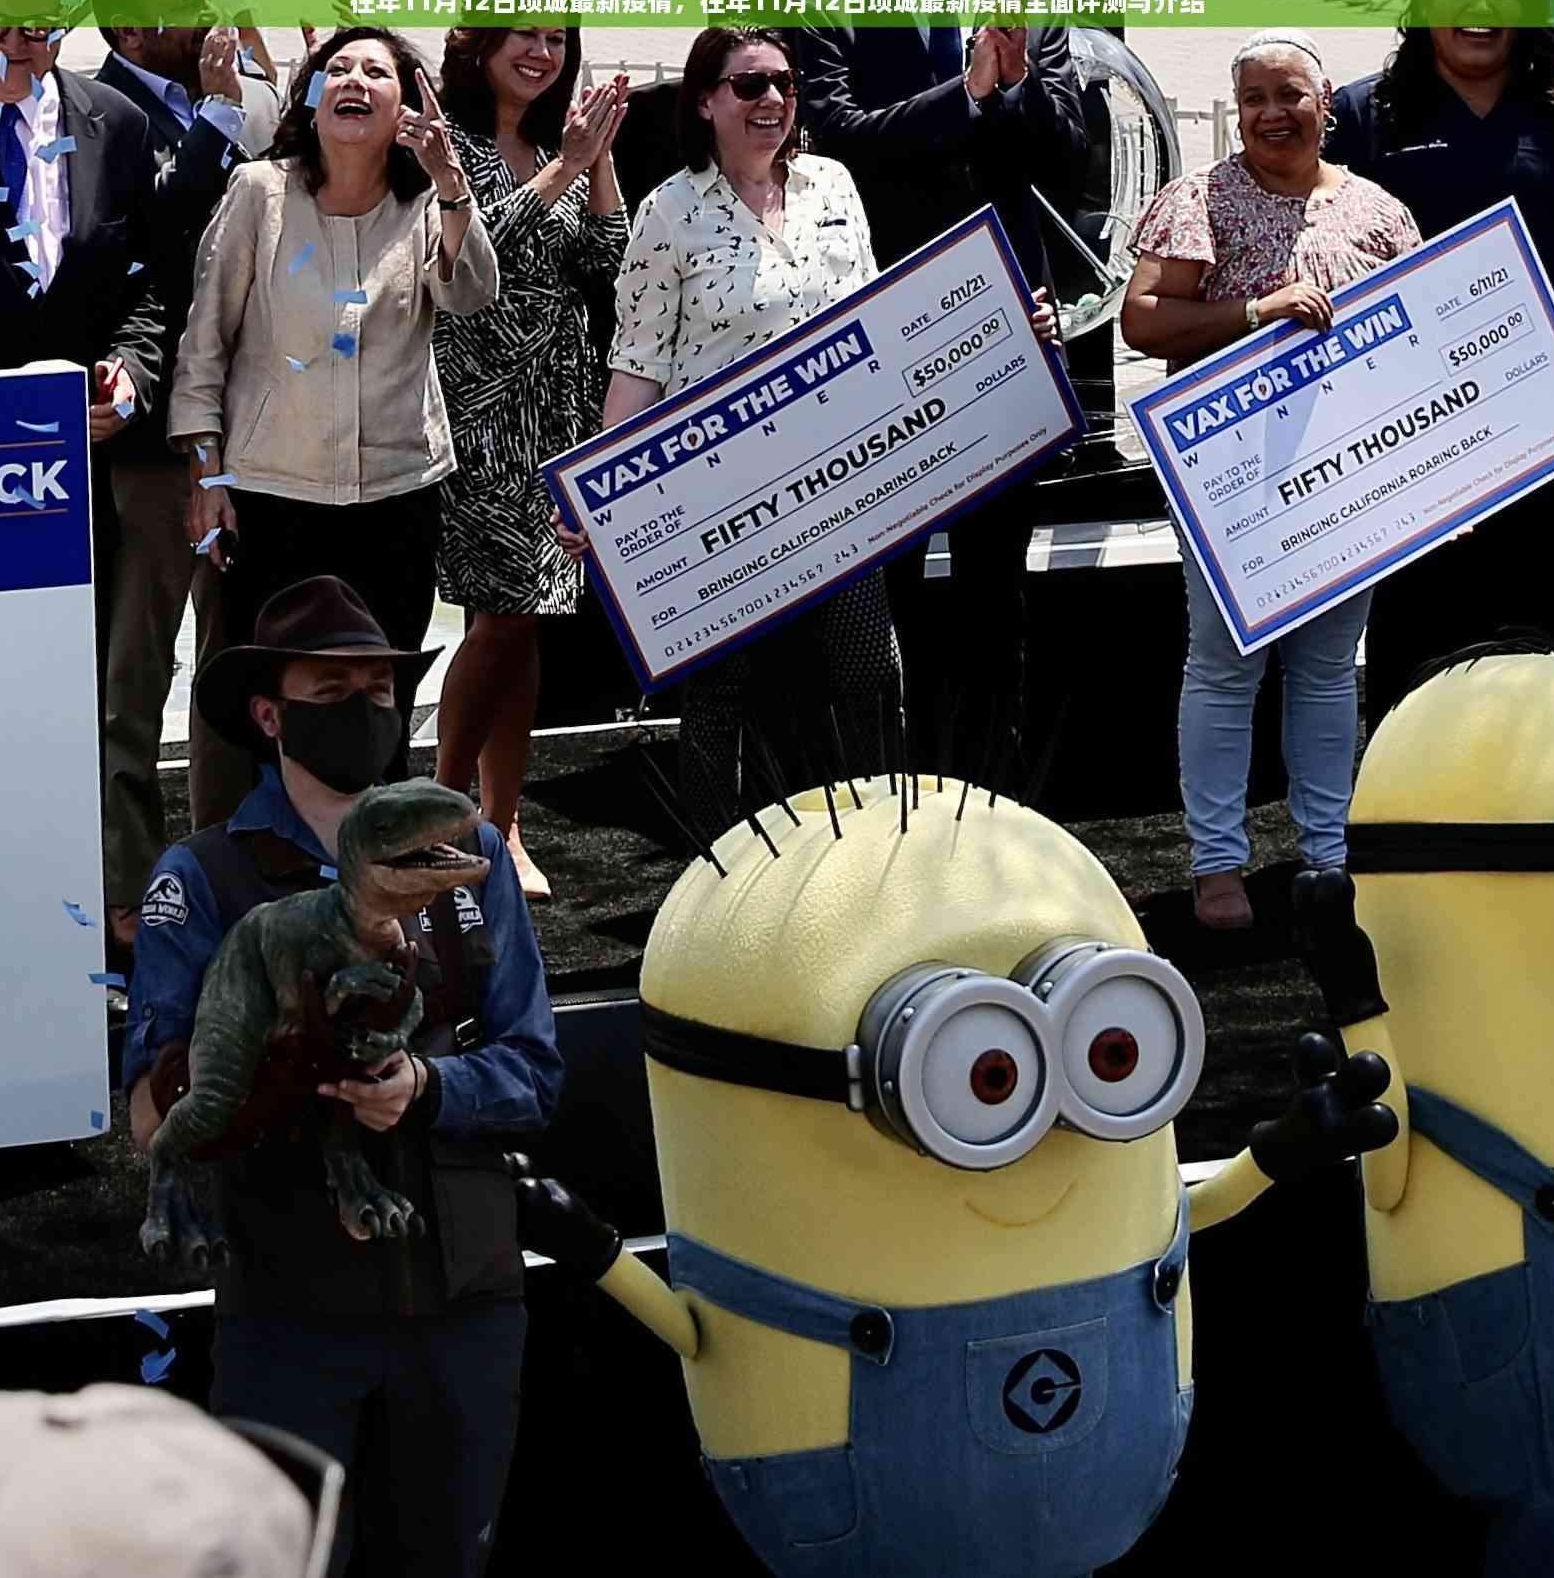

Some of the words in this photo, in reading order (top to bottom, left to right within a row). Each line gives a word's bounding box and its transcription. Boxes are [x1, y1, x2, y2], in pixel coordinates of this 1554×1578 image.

[901, 313, 932, 337] DATE
[940, 274, 987, 311] 6/11/21
[1436, 296, 1462, 316] DATE
[1469, 267, 1509, 297] 6/11/21
[975, 354, 1027, 393] DOLLARS
[1172, 395, 1236, 442] VAX
[1234, 365, 1294, 412] FOR
[1290, 336, 1346, 379] THE
[1344, 305, 1403, 350] WIN
[1505, 352, 1549, 382] DOLLARS
[586, 450, 659, 499] VAX
[660, 414, 728, 463] FOR
[729, 375, 794, 423] THE
[795, 333, 863, 385] WIN
[1203, 473, 1224, 490] PAY
[1225, 466, 1240, 479] TO
[1240, 454, 1263, 471] THE
[1224, 506, 1271, 537] AMOUNT
[1277, 453, 1345, 506] FIFTY
[1347, 380, 1481, 466] THOUSAND
[635, 556, 690, 592] AMOUNT
[699, 494, 780, 555] FIFTY
[785, 397, 946, 505] THOUSAND
[1208, 476, 1245, 502] ORDER
[1241, 556, 1265, 575] FOR
[1280, 513, 1340, 552] BRINGING
[1340, 475, 1409, 519] CALIFORNIA
[1409, 444, 1461, 480] ROARING
[1461, 425, 1494, 451] BACK
[614, 528, 638, 548] PAY
[640, 519, 658, 533] TO
[659, 504, 686, 523] THE
[620, 530, 663, 557] ORDER
[665, 518, 682, 533] OF
[651, 606, 678, 626] FOR
[697, 554, 768, 601] BRINGING
[770, 505, 856, 561] CALIFORNIA
[855, 467, 918, 512] ROARING
[918, 441, 958, 472] BACK
